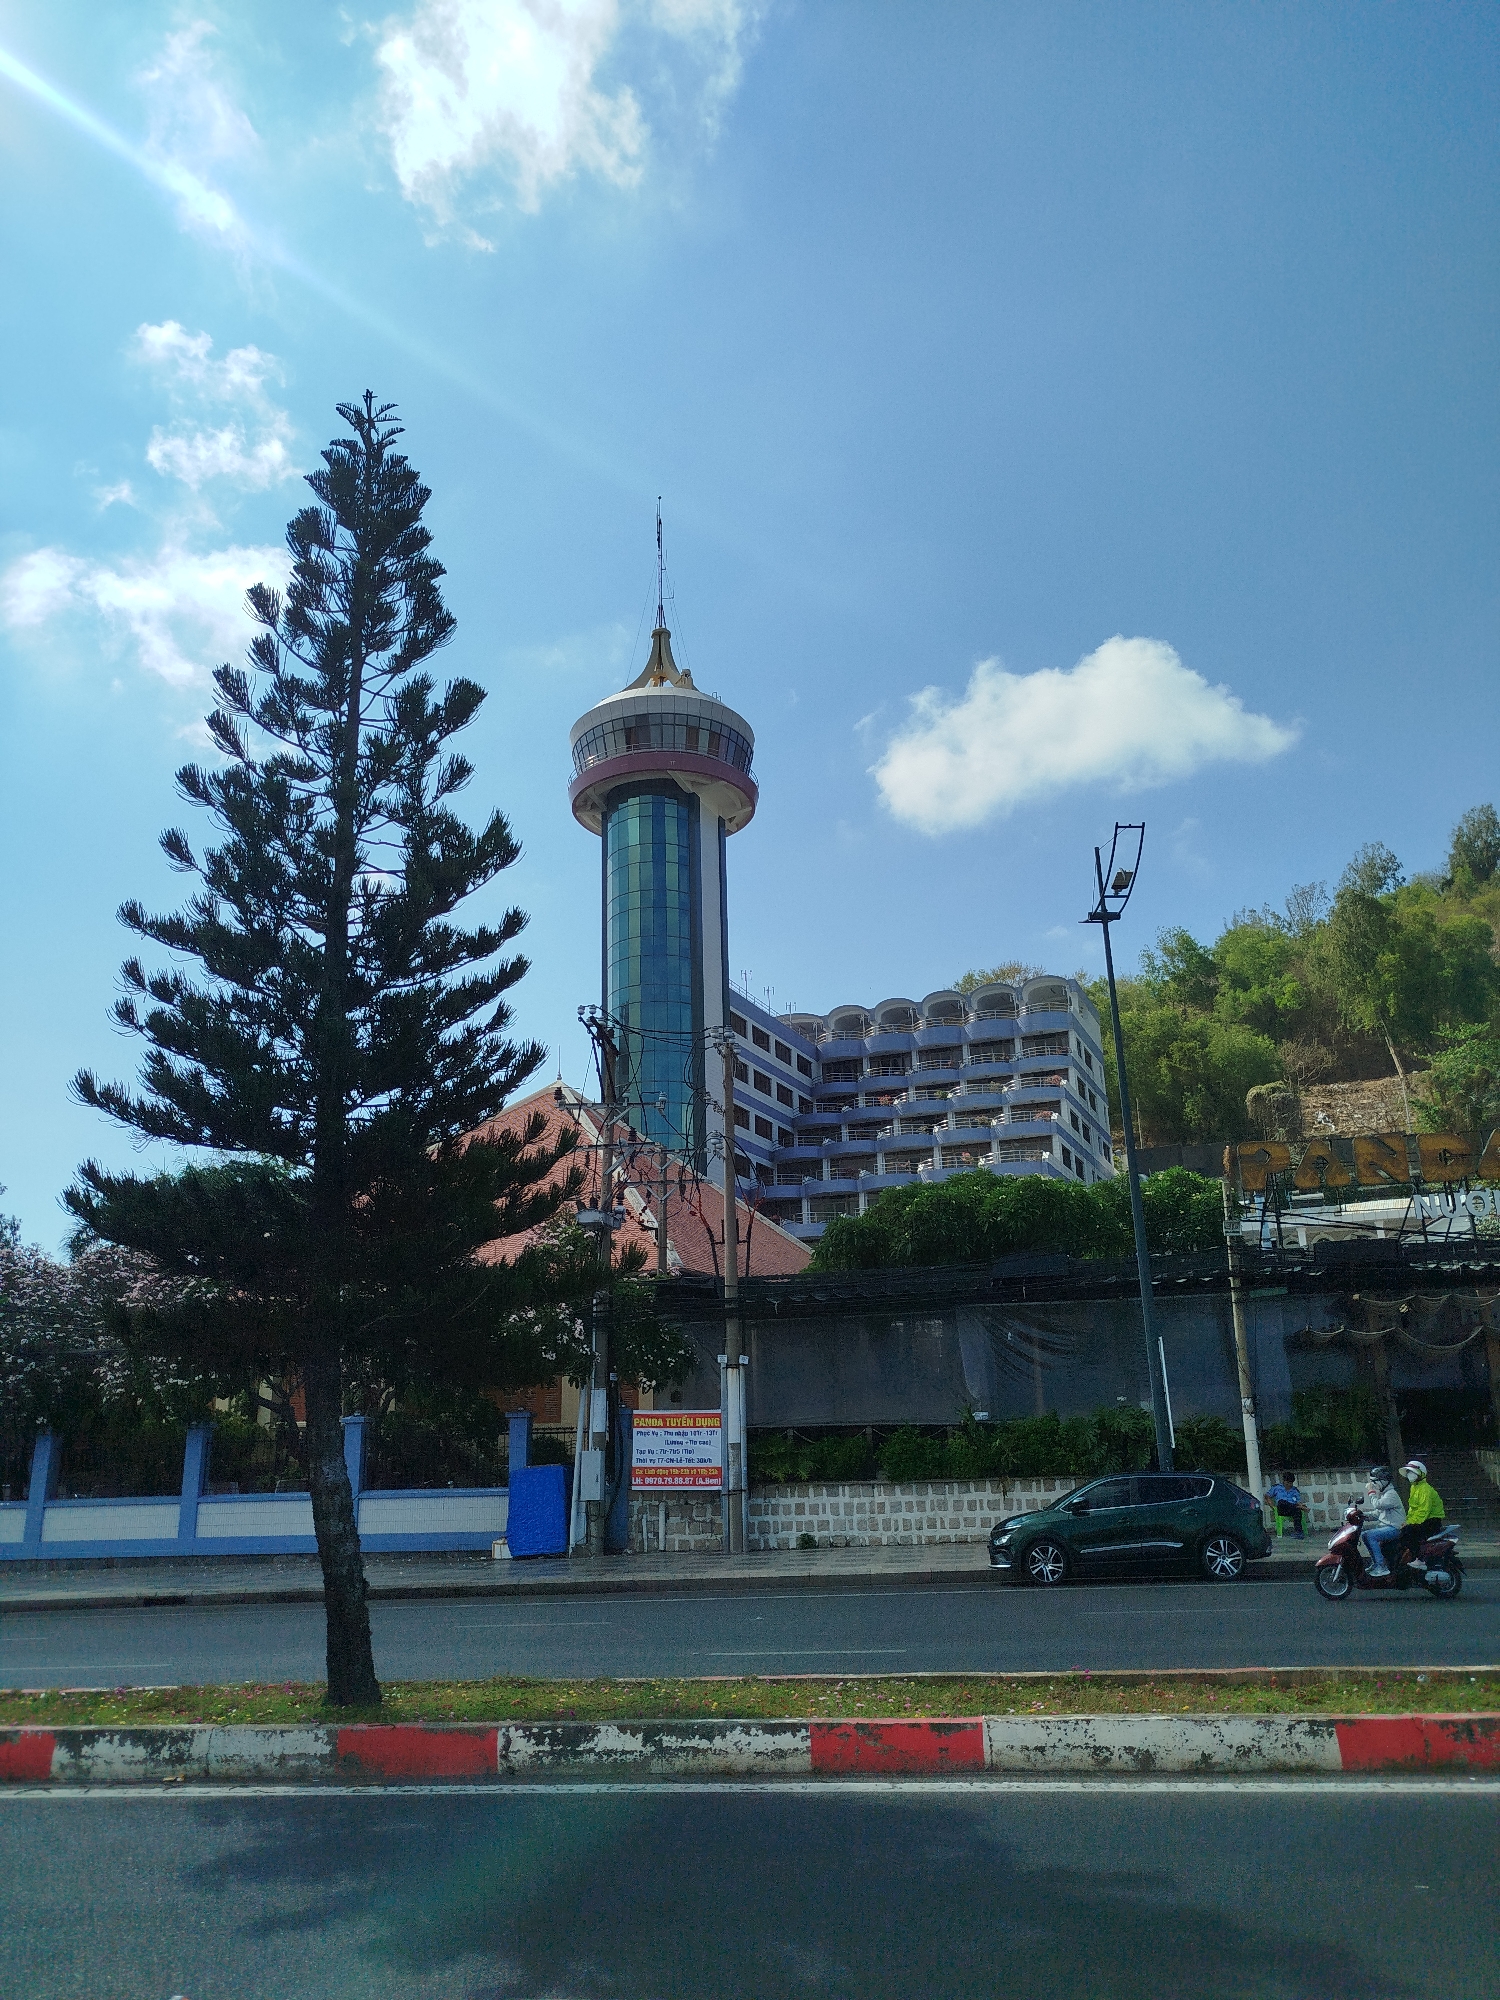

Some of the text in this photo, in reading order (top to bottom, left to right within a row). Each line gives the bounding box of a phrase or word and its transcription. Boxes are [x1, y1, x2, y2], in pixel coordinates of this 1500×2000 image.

[1413, 1184, 1500, 1220] NƯỚ
[634, 1415, 720, 1427] PANDA TUYỂN DỤNG
